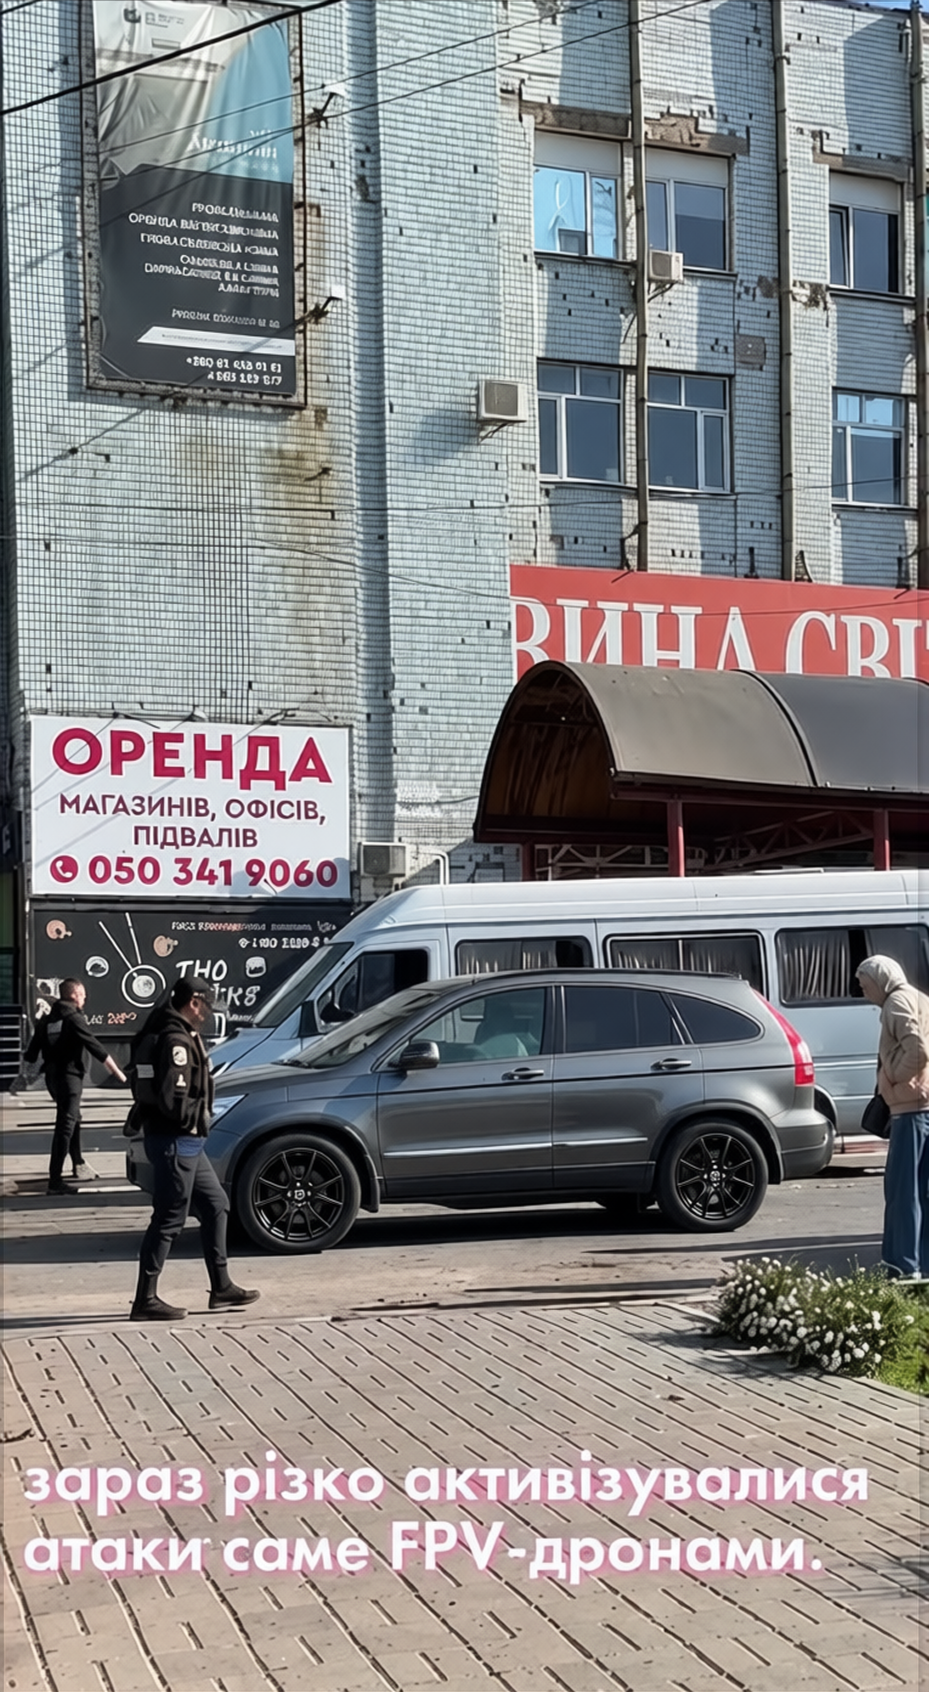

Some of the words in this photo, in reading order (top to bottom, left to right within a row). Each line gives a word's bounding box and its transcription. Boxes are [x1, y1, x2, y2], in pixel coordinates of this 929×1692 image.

[508, 596, 756, 680] ВИНА
[785, 611, 929, 679] СВІ
[52, 727, 333, 791] ОРЕНДА
[59, 793, 217, 822] МАГАЗИНІВ,
[224, 799, 326, 826] ОФІСІВ,
[133, 825, 259, 850] ПІДВАЛІВ
[88, 855, 161, 886] 050
[172, 857, 233, 887] 341
[245, 858, 339, 889] 9060
